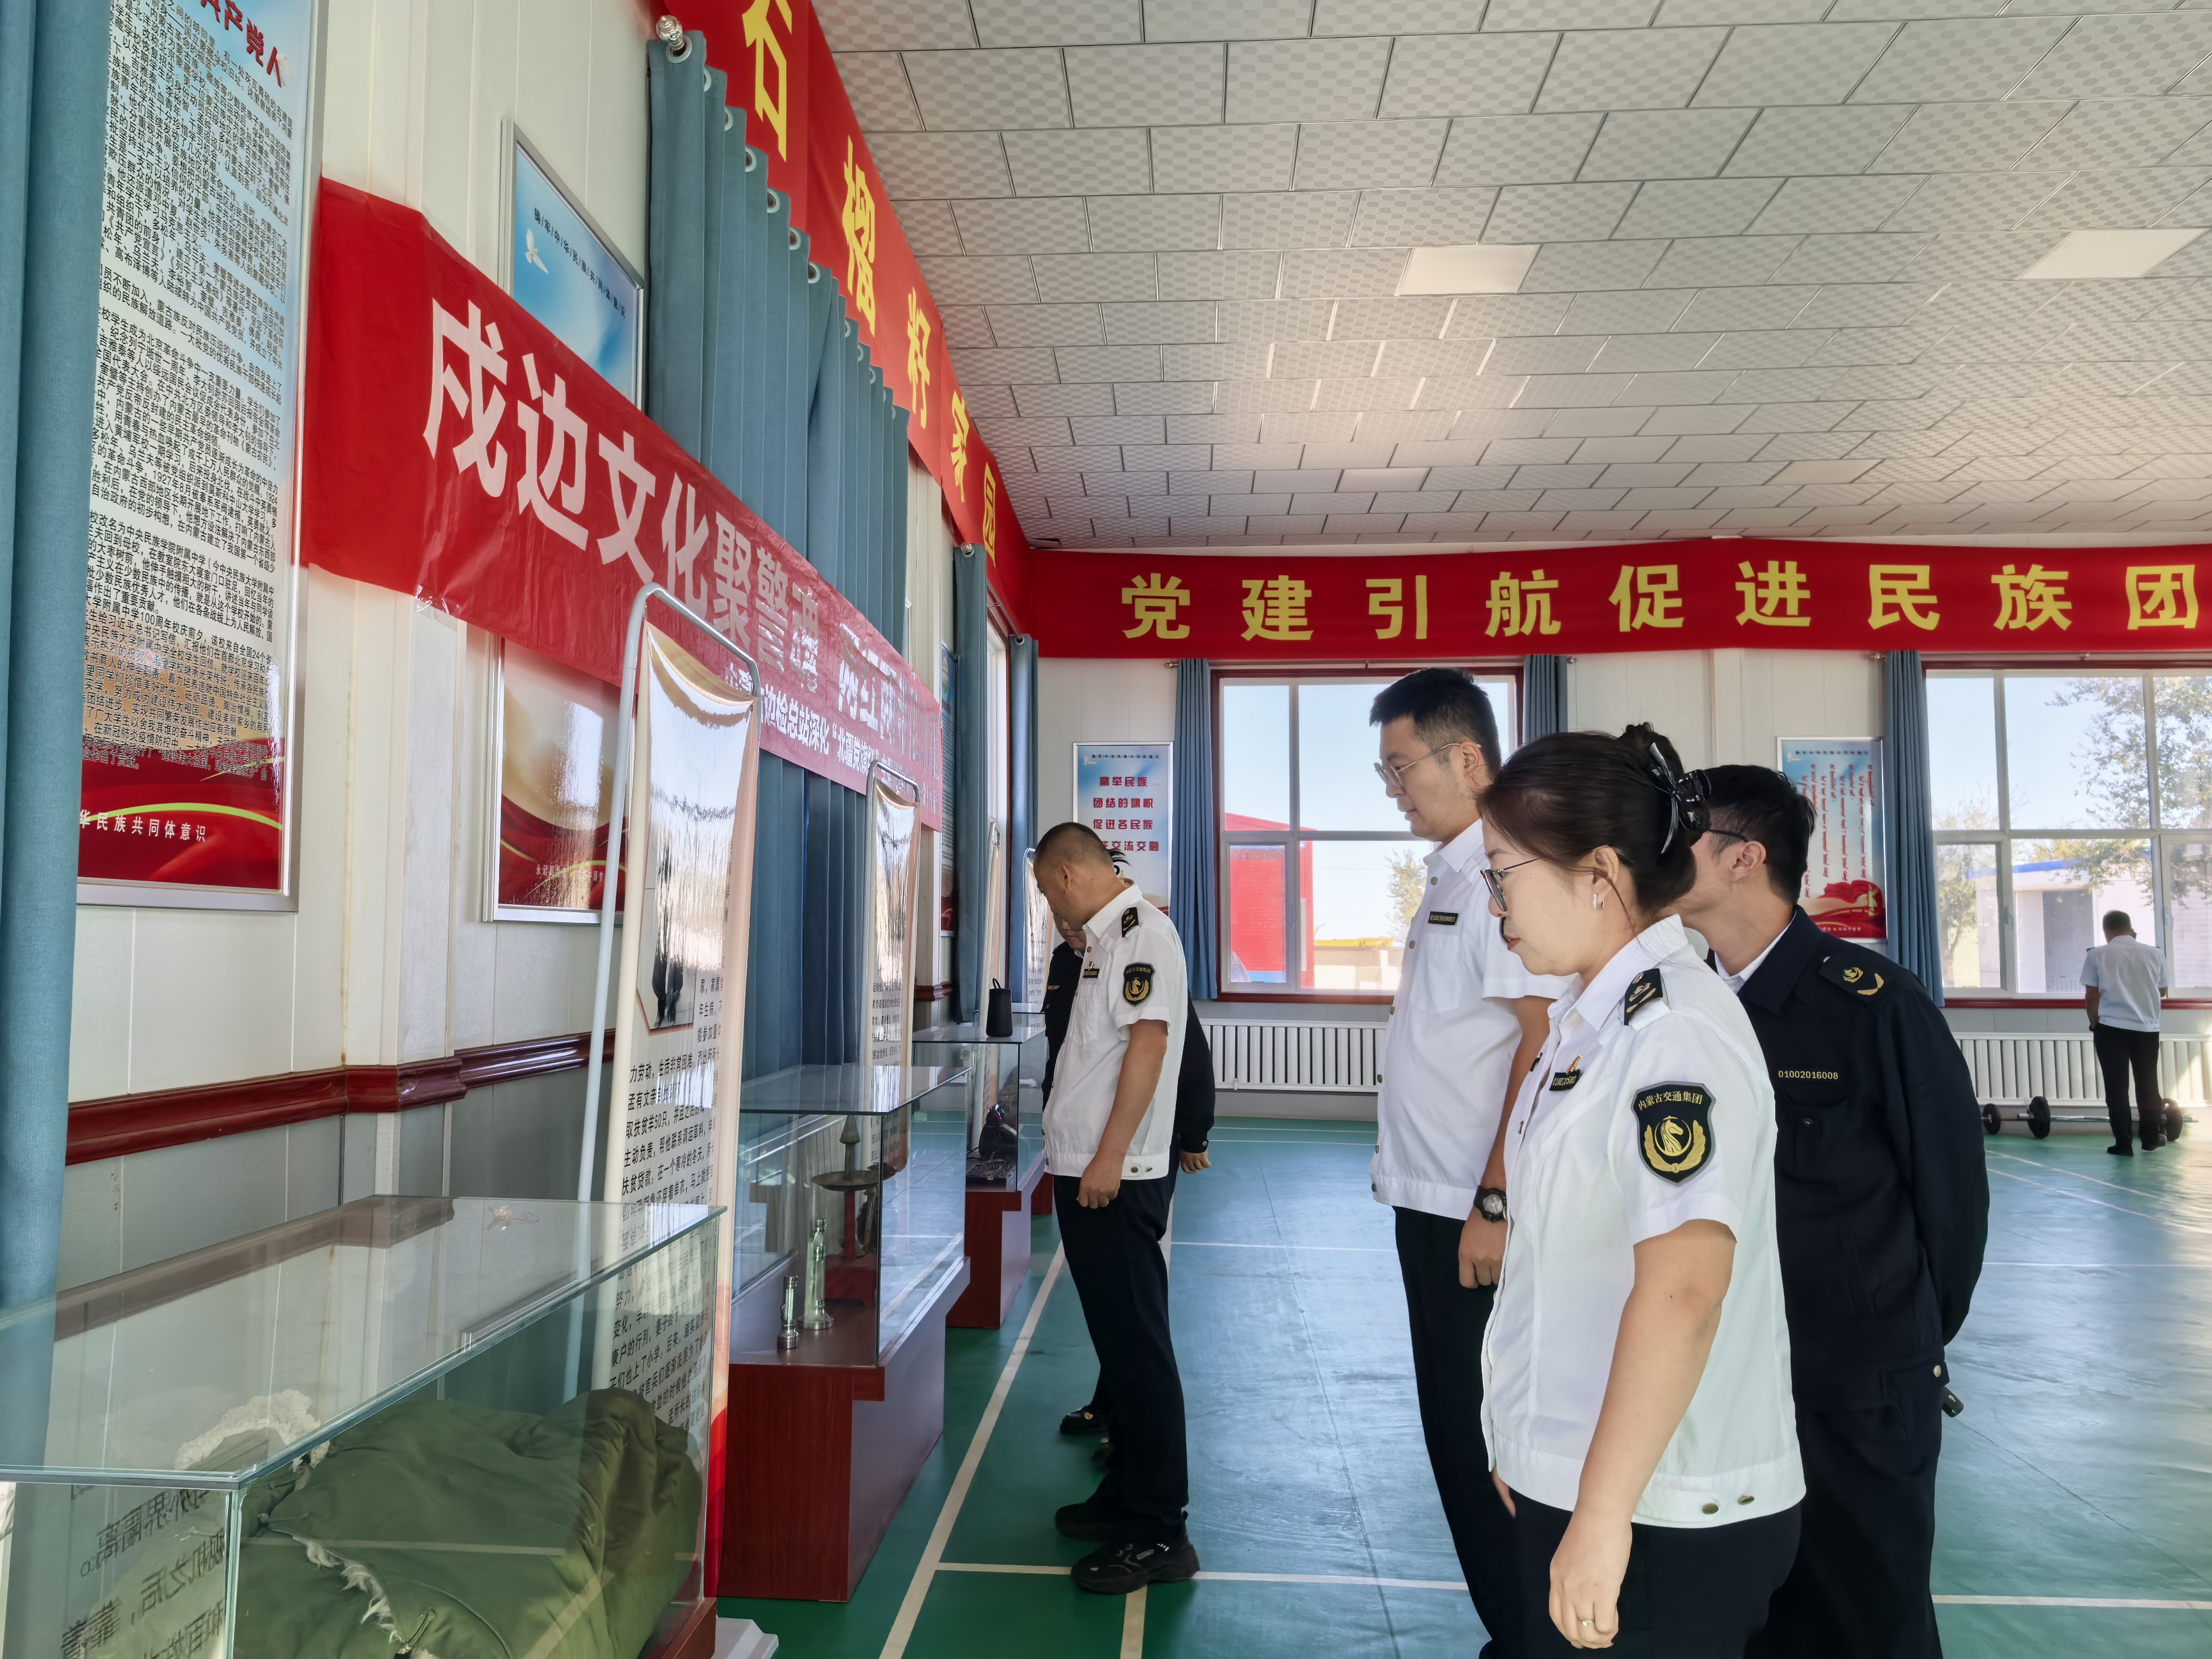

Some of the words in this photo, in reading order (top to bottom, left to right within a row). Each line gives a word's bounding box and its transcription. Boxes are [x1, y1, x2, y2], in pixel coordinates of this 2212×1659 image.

[106, 102, 286, 260] 民的反抗斗争。要想把内蒙古地区的民族解放运动引导到
[107, 76, 219, 177] 制，他们连续发动了几次学潮。
[107, 63, 288, 228] 族青年学生十分珍惜学习机会，认真刻苦。因为不满北洋
[108, 50, 275, 204] 族振兴的热血青年，千里迢迢从内蒙古来到了北京。
[103, 168, 201, 250] 青年学生学习马克思主义。
[104, 142, 285, 294] 欺压群众的情况，对学生进行革命启蒙教育，鼓励学生们
[105, 116, 286, 272] 批坚持共产主义信仰的干部。中共北方区委负责人李大钊
[97, 318, 280, 439] 、纪念列宁逝世一周年、李大钊赴苏回国后报告会等革命
[98, 303, 280, 427] 校学生成为北京革命斗争中一支重要力量。学生们参加了
[99, 262, 281, 393] 员不断加入，蒙古族反对民族压迫的斗争，由自发走上了
[99, 276, 281, 405] 织的民族解放道路。一大批党的优秀民族干部快速成长起
[93, 413, 277, 517] 进入黄埔军校一期学习，后来投身北伐，在战斗中英勇牺
[95, 386, 278, 495] 中，内蒙古的一些早期共产党员逐渐成长为革命的中坚力
[91, 454, 275, 551] ，在内蒙古西部地区长期开展地下工作，打响了内蒙古人
[1122, 561, 2199, 640] 党建引航促进民族团
[83, 691, 239, 738] 团结进步、实现共同繁荣发展作出应有贡献。
[1093, 819, 1153, 830] 促进各民族
[1638, 1091, 1703, 1111] 内蒙古交通集团
[1778, 1070, 1838, 1080] 01002016008
